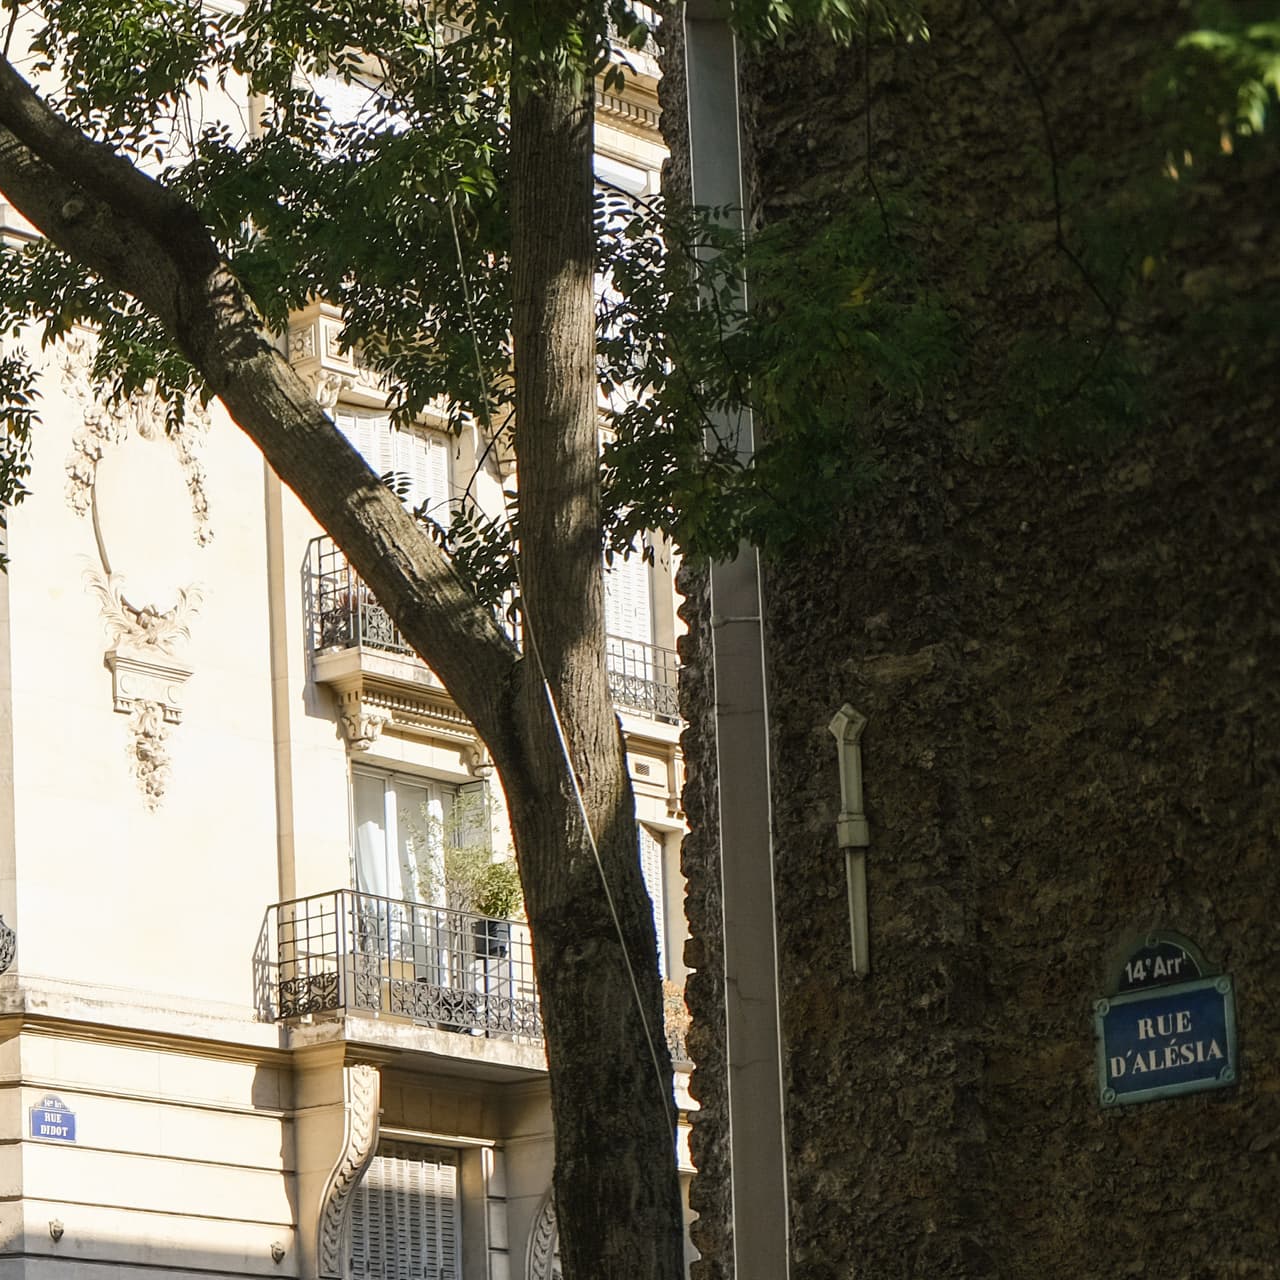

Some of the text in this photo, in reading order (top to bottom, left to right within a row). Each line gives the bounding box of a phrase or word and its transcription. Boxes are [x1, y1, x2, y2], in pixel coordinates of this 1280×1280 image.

[1137, 1010, 1192, 1040] RUE
[1110, 1037, 1224, 1078] D'ALÉSIA
[44, 1112, 62, 1123] RUE
[40, 1124, 68, 1137] DIDOT
